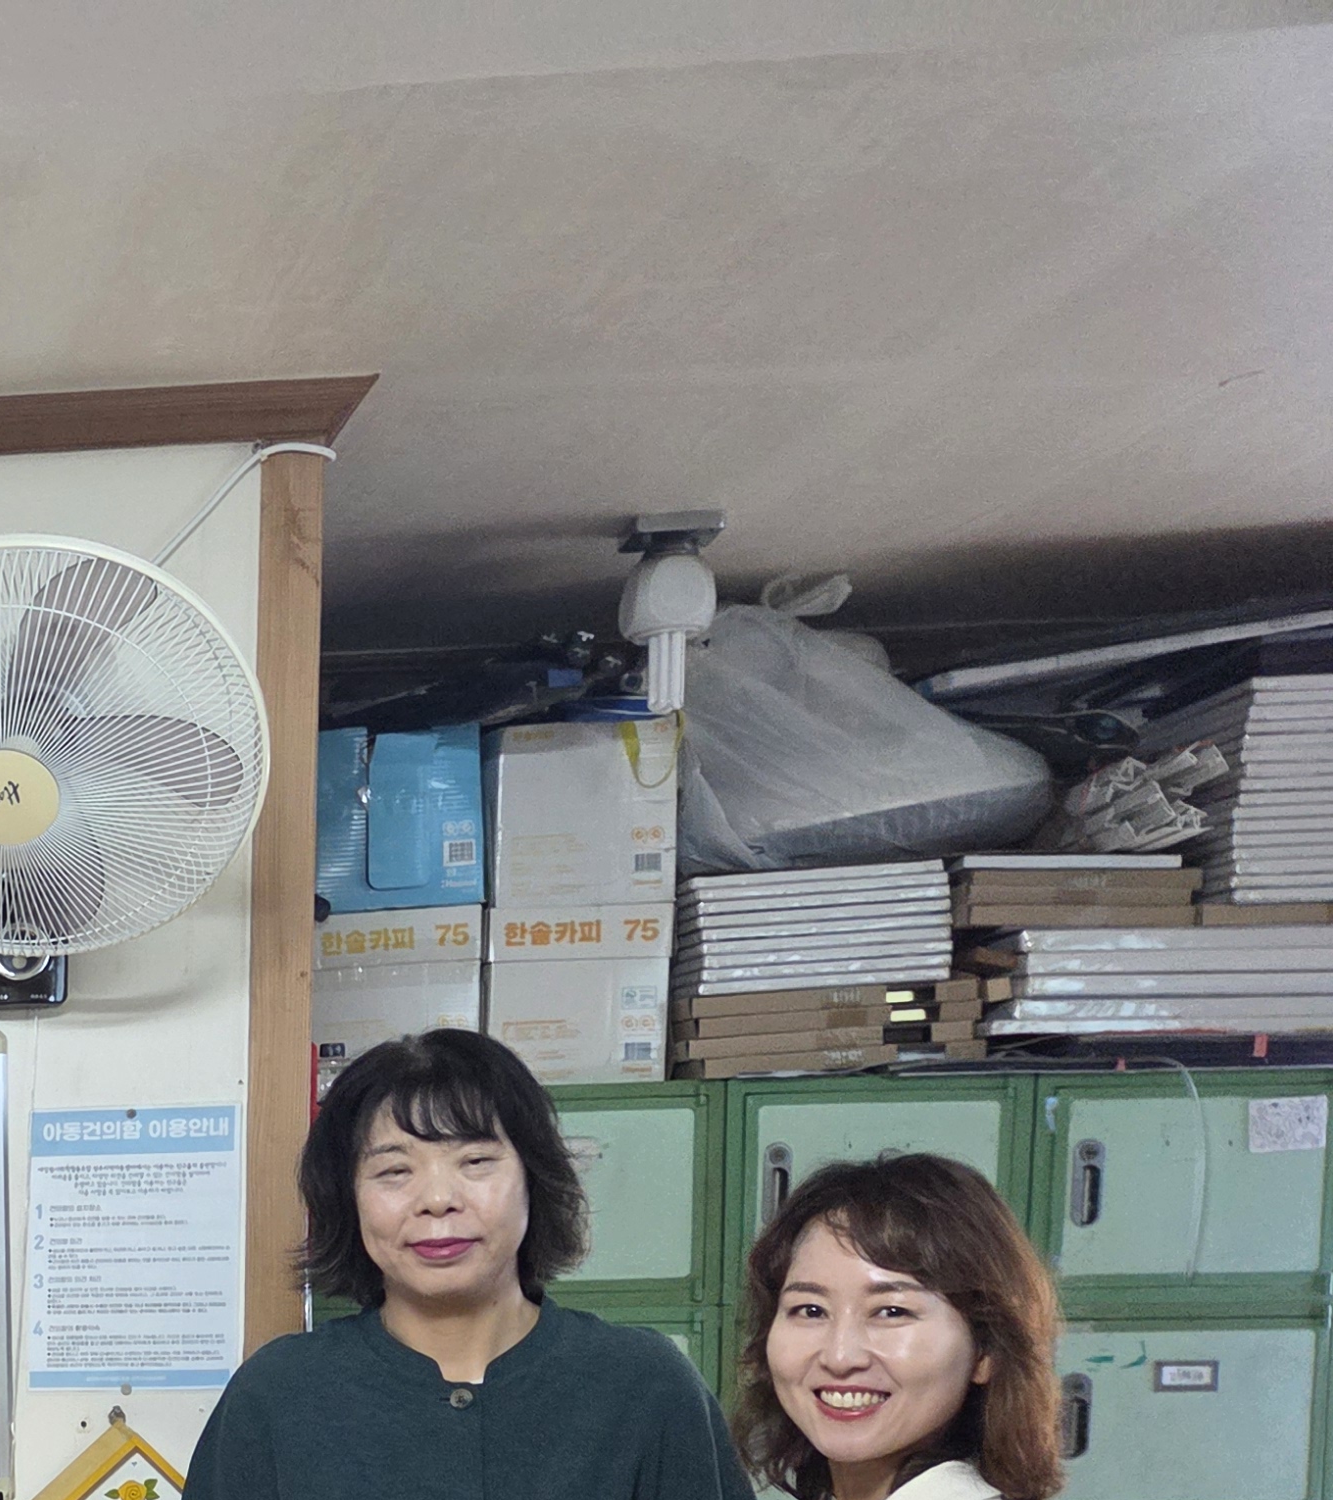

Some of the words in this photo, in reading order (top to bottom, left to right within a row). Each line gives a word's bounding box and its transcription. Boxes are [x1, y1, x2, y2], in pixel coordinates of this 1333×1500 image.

[320, 926, 415, 956] 한솔카피
[435, 923, 470, 947] 75
[504, 919, 602, 947] 한솔카피
[623, 918, 660, 942] 75
[42, 1119, 143, 1141] 아동건의함
[148, 1117, 229, 1138] 이용안내
[35, 1204, 43, 1219] 1
[33, 1234, 45, 1250] 2
[33, 1274, 44, 1289] 3
